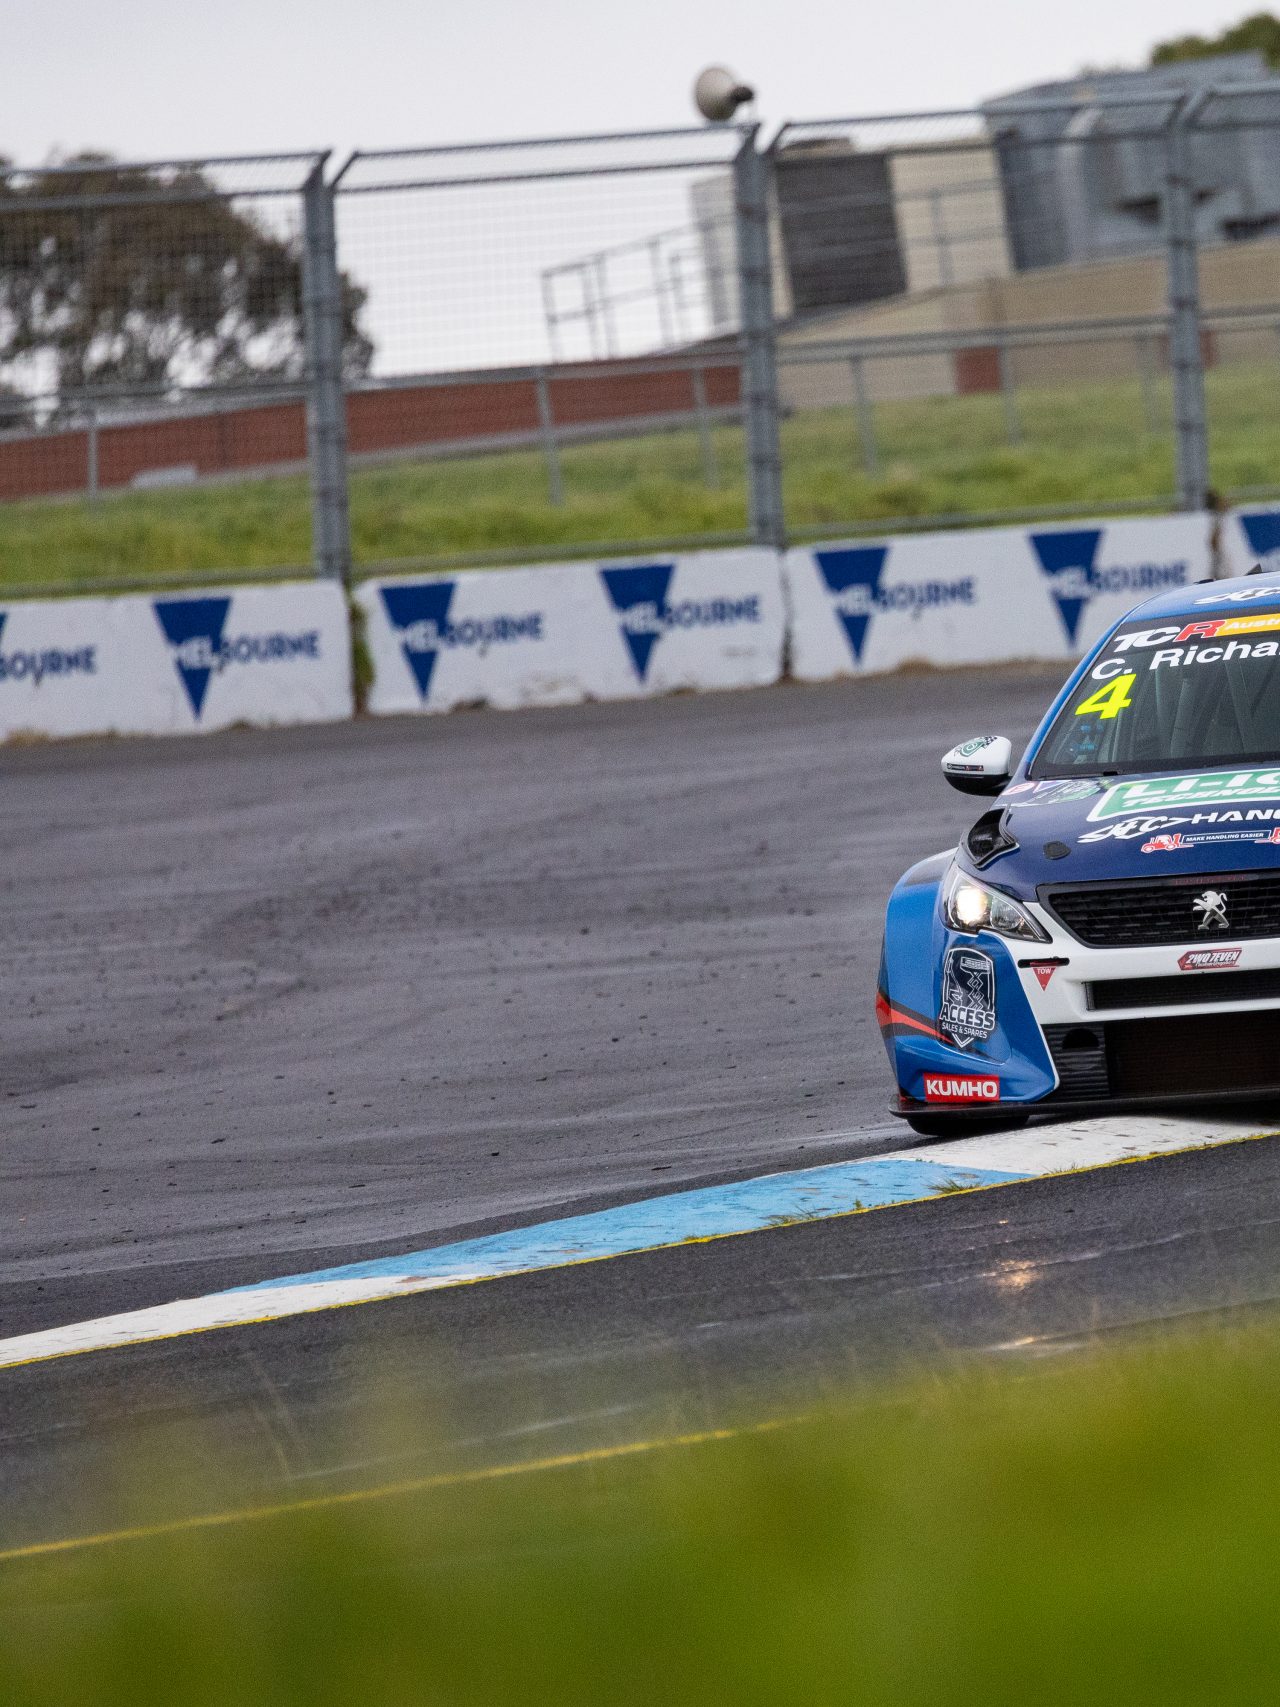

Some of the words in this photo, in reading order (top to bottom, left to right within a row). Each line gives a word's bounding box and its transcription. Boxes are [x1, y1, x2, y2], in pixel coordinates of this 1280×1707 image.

[1114, 619, 1227, 653] TCR
[1092, 658, 1133, 680] C.
[1075, 674, 1137, 719] 4
[939, 1002, 996, 1031] ACCESS
[942, 1021, 959, 1034] SALES
[964, 1028, 988, 1039] SPARES
[926, 1079, 998, 1098] KUMHO
